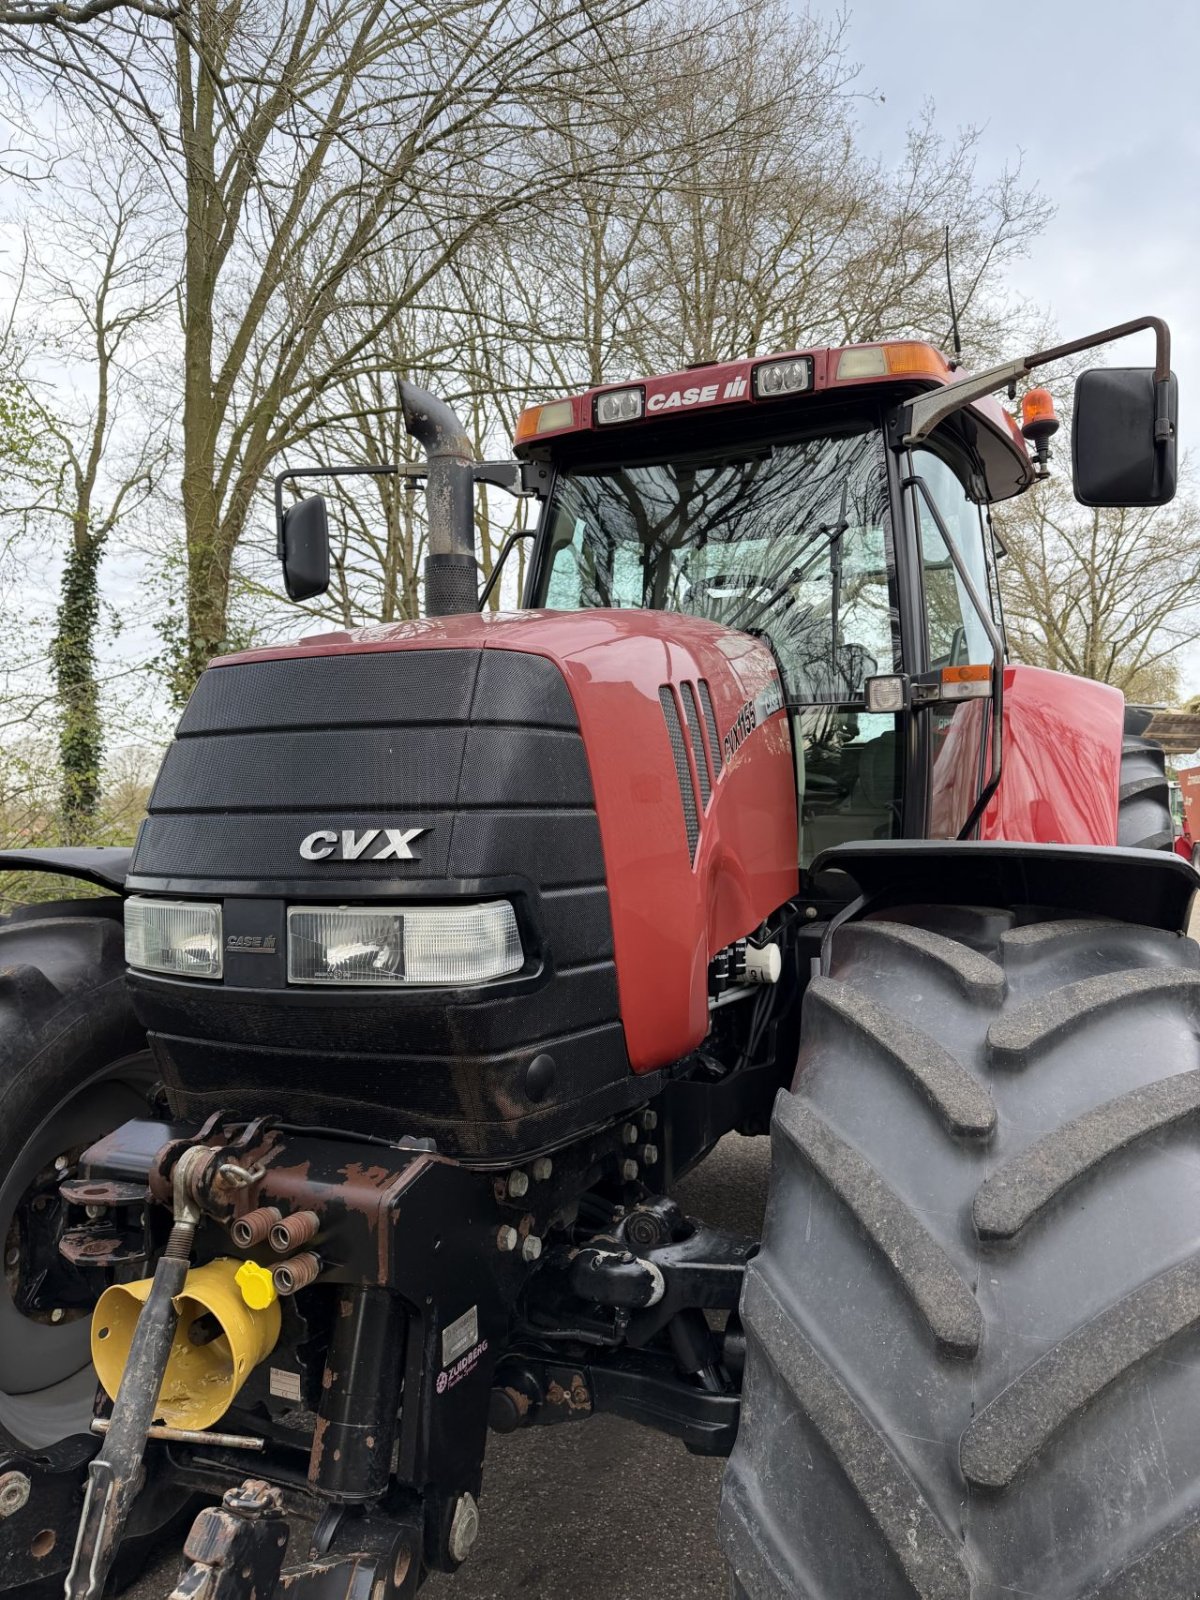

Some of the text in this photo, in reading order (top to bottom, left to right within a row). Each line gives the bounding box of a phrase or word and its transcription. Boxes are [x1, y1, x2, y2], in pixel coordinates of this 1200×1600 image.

[647, 384, 719, 411] CASE
[299, 828, 425, 860] CVX
[227, 935, 262, 947] CASE
[448, 1339, 488, 1380] ZUIDBERG
